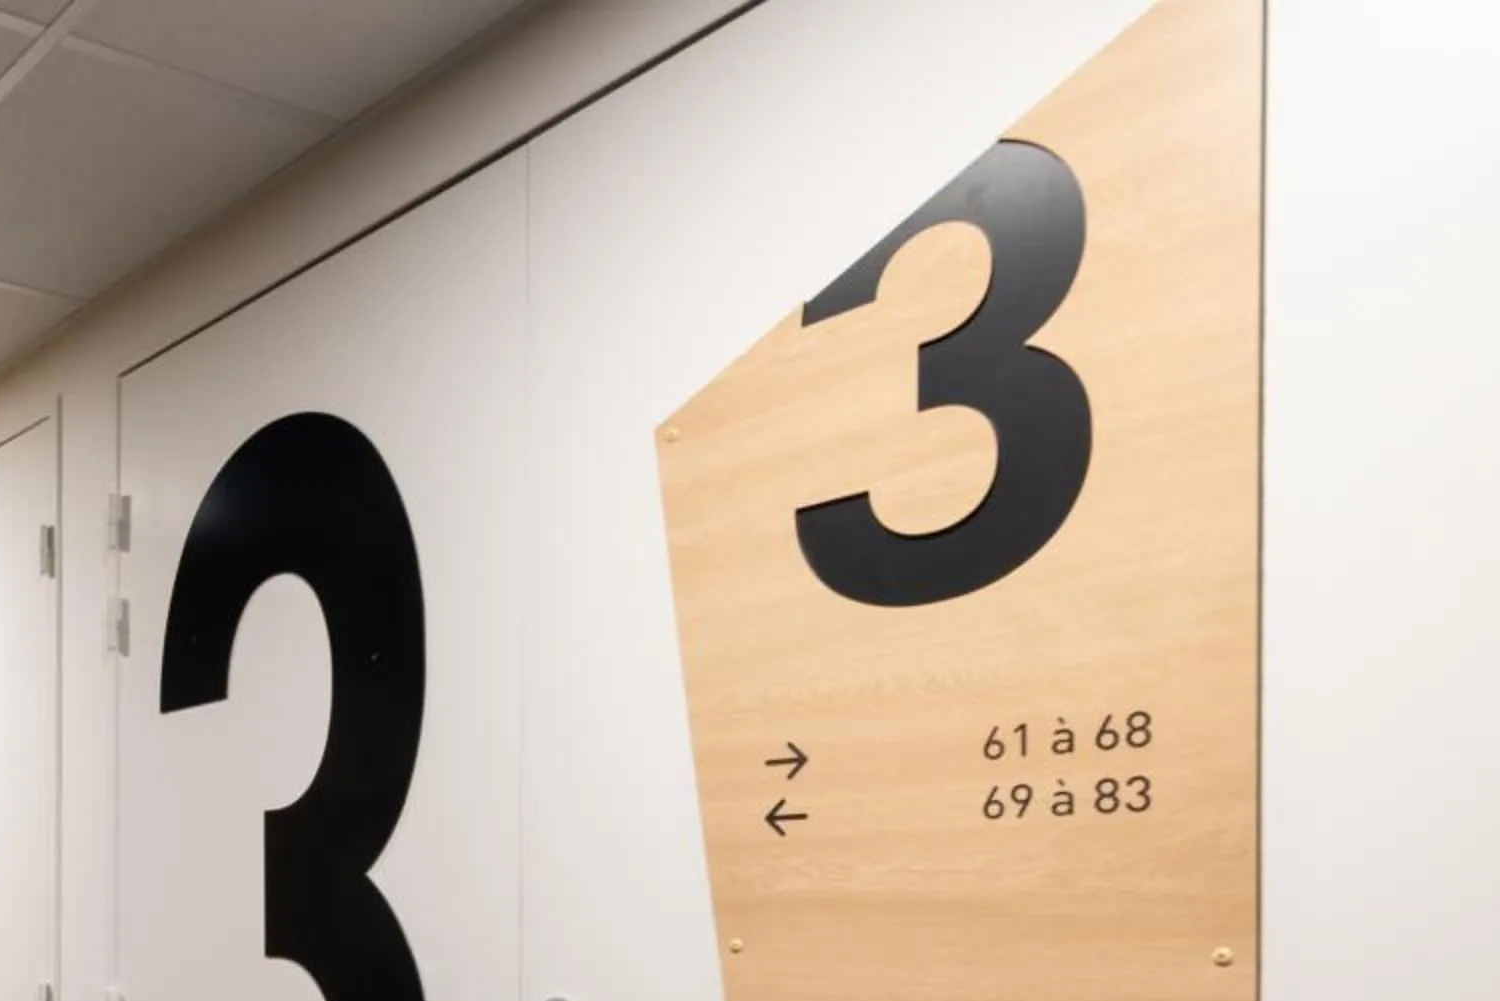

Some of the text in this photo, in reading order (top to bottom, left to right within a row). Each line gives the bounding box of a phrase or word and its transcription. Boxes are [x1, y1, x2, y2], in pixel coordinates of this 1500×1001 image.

[795, 139, 1092, 608] 3
[982, 710, 1153, 760] 61 à 68
[982, 775, 1152, 819] 69 à 83
